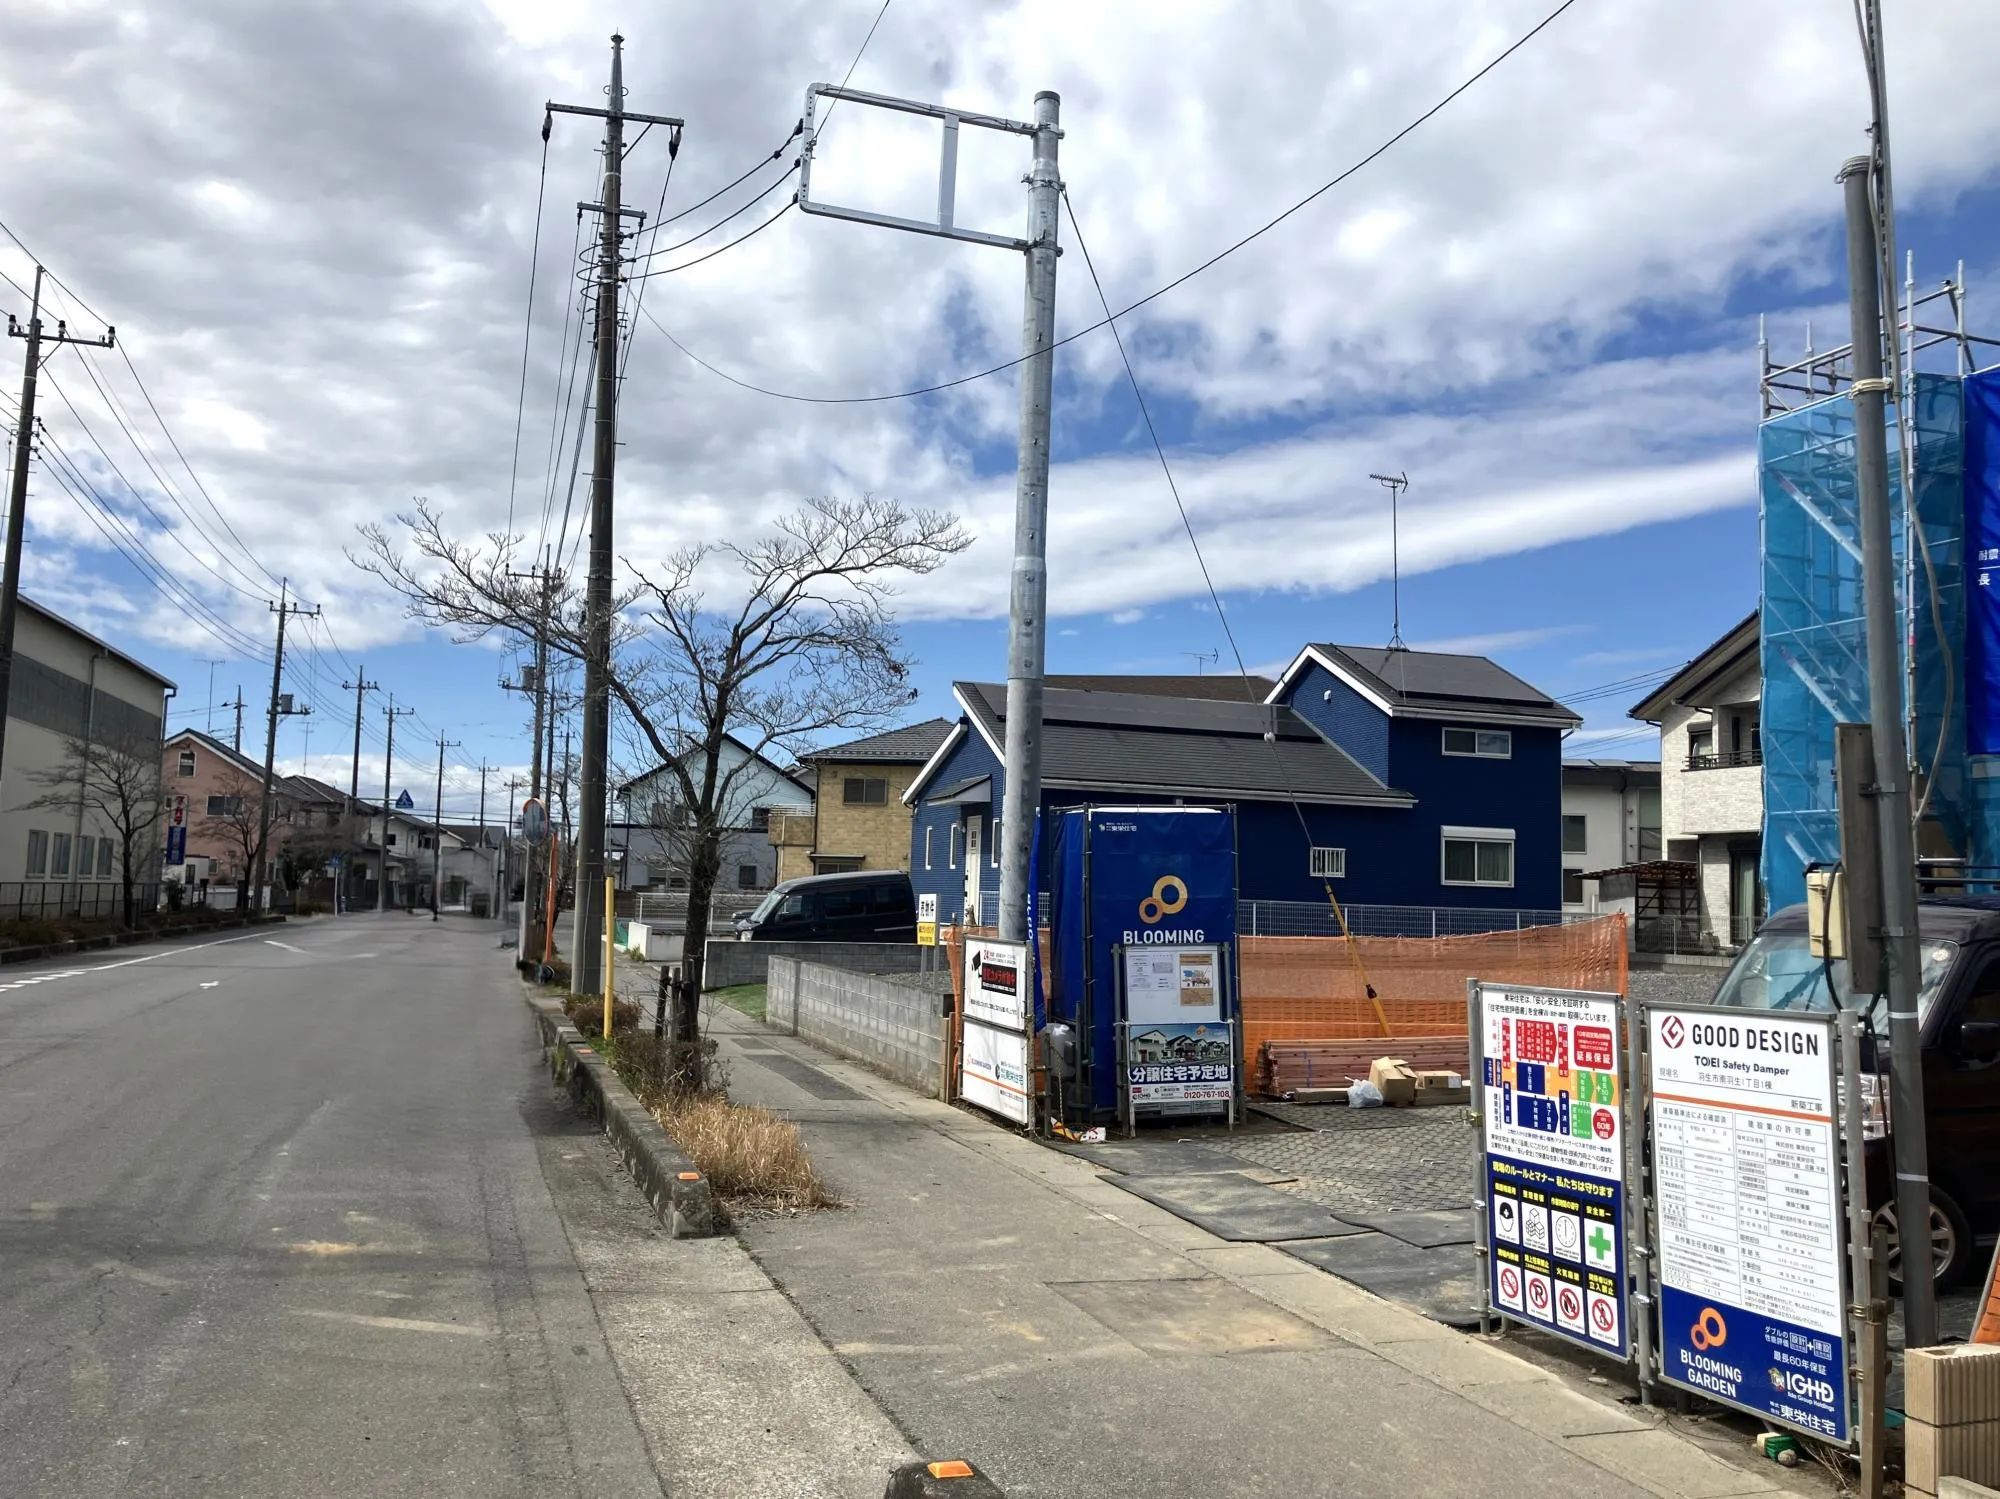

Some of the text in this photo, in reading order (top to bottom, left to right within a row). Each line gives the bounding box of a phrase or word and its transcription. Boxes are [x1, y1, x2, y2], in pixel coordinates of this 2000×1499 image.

[1123, 929, 1205, 945] BLOOMING
[1692, 1023, 1819, 1056] GOOD DESIGN
[1132, 1064, 1228, 1083] 分譲住宅予定地
[1722, 1060, 1751, 1073] Safety
[1753, 1063, 1790, 1076] Damper
[1184, 1090, 1229, 1099] 0120-767-108
[1791, 1099, 1823, 1112] 新築工事
[1764, 1325, 1789, 1339] ダブルの
[1791, 1335, 1806, 1345] 設計
[1680, 1349, 1742, 1383] BLOOMING
[1773, 1350, 1827, 1376] 最長60年保証
[1687, 1368, 1736, 1398] GARDEN
[1786, 1371, 1834, 1403] IGHD
[1780, 1404, 1836, 1435] 東栄住宅
